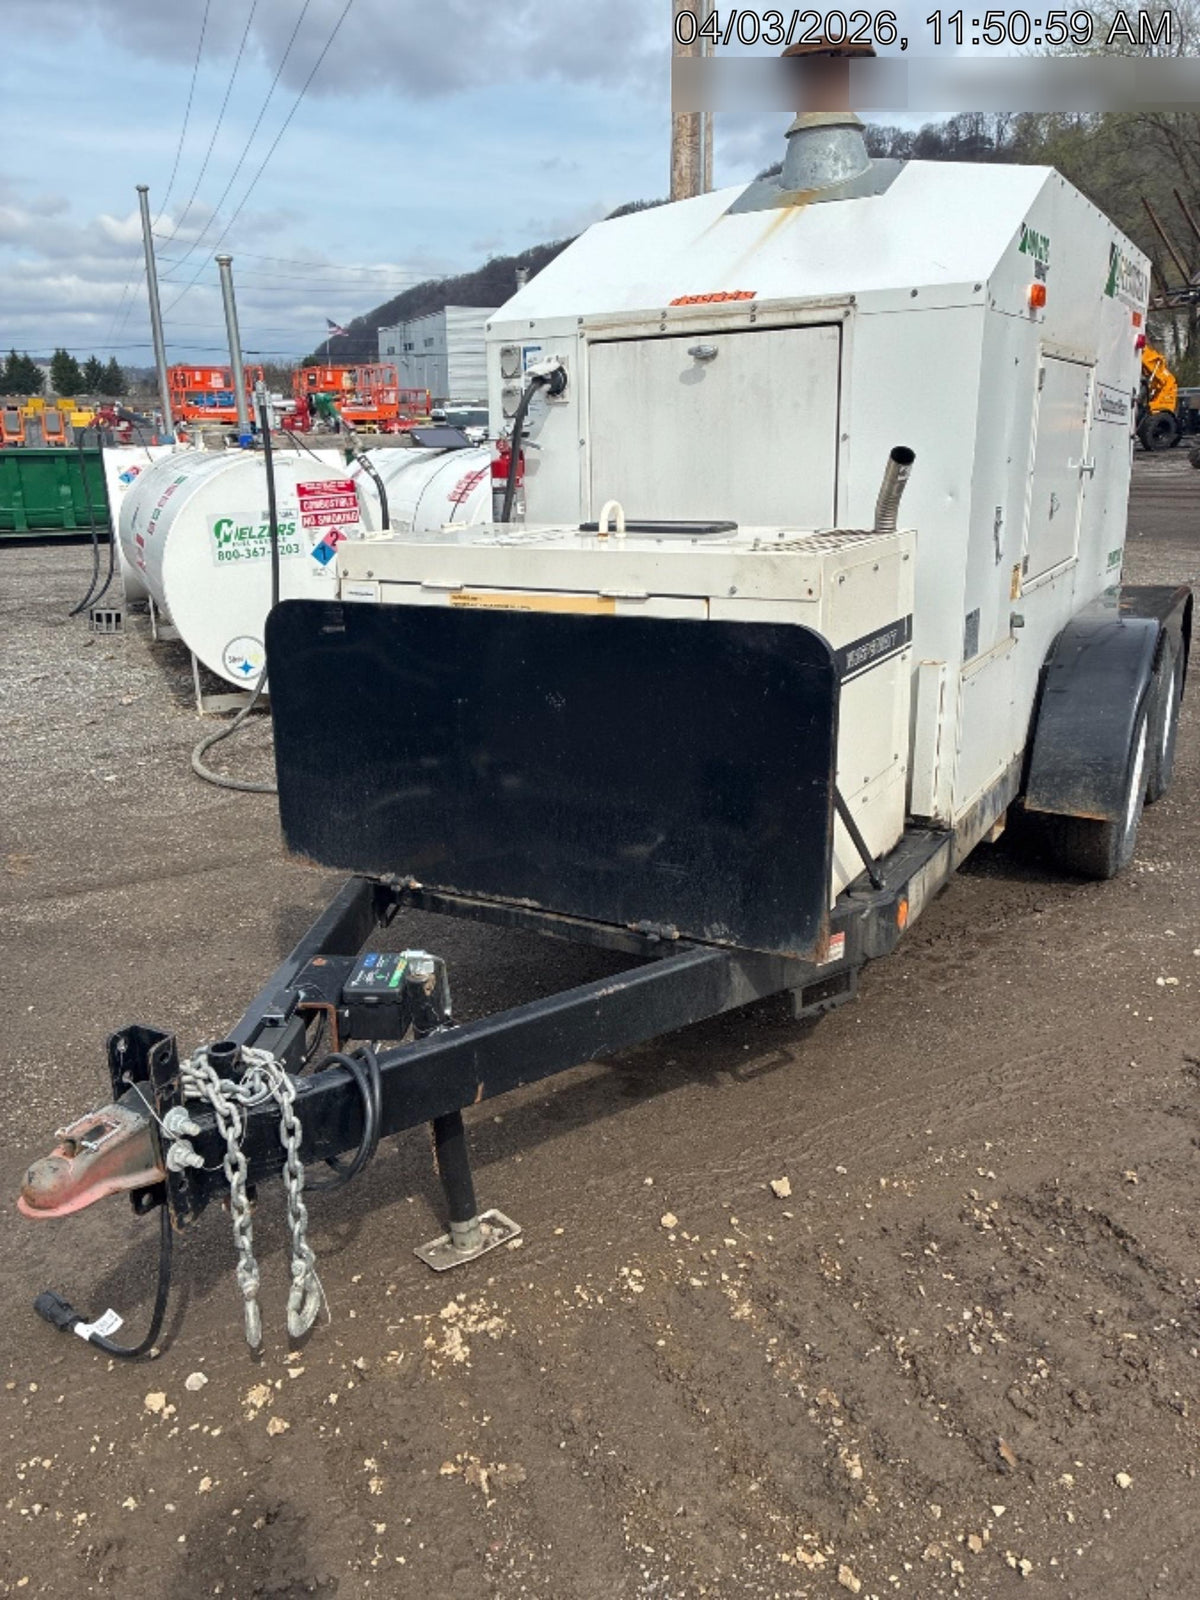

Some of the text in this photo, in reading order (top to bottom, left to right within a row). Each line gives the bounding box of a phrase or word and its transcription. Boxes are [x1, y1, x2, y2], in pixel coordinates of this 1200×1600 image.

[329, 531, 340, 547] 2
[217, 543, 300, 561] 800-367-203
[319, 545, 327, 561] 1
